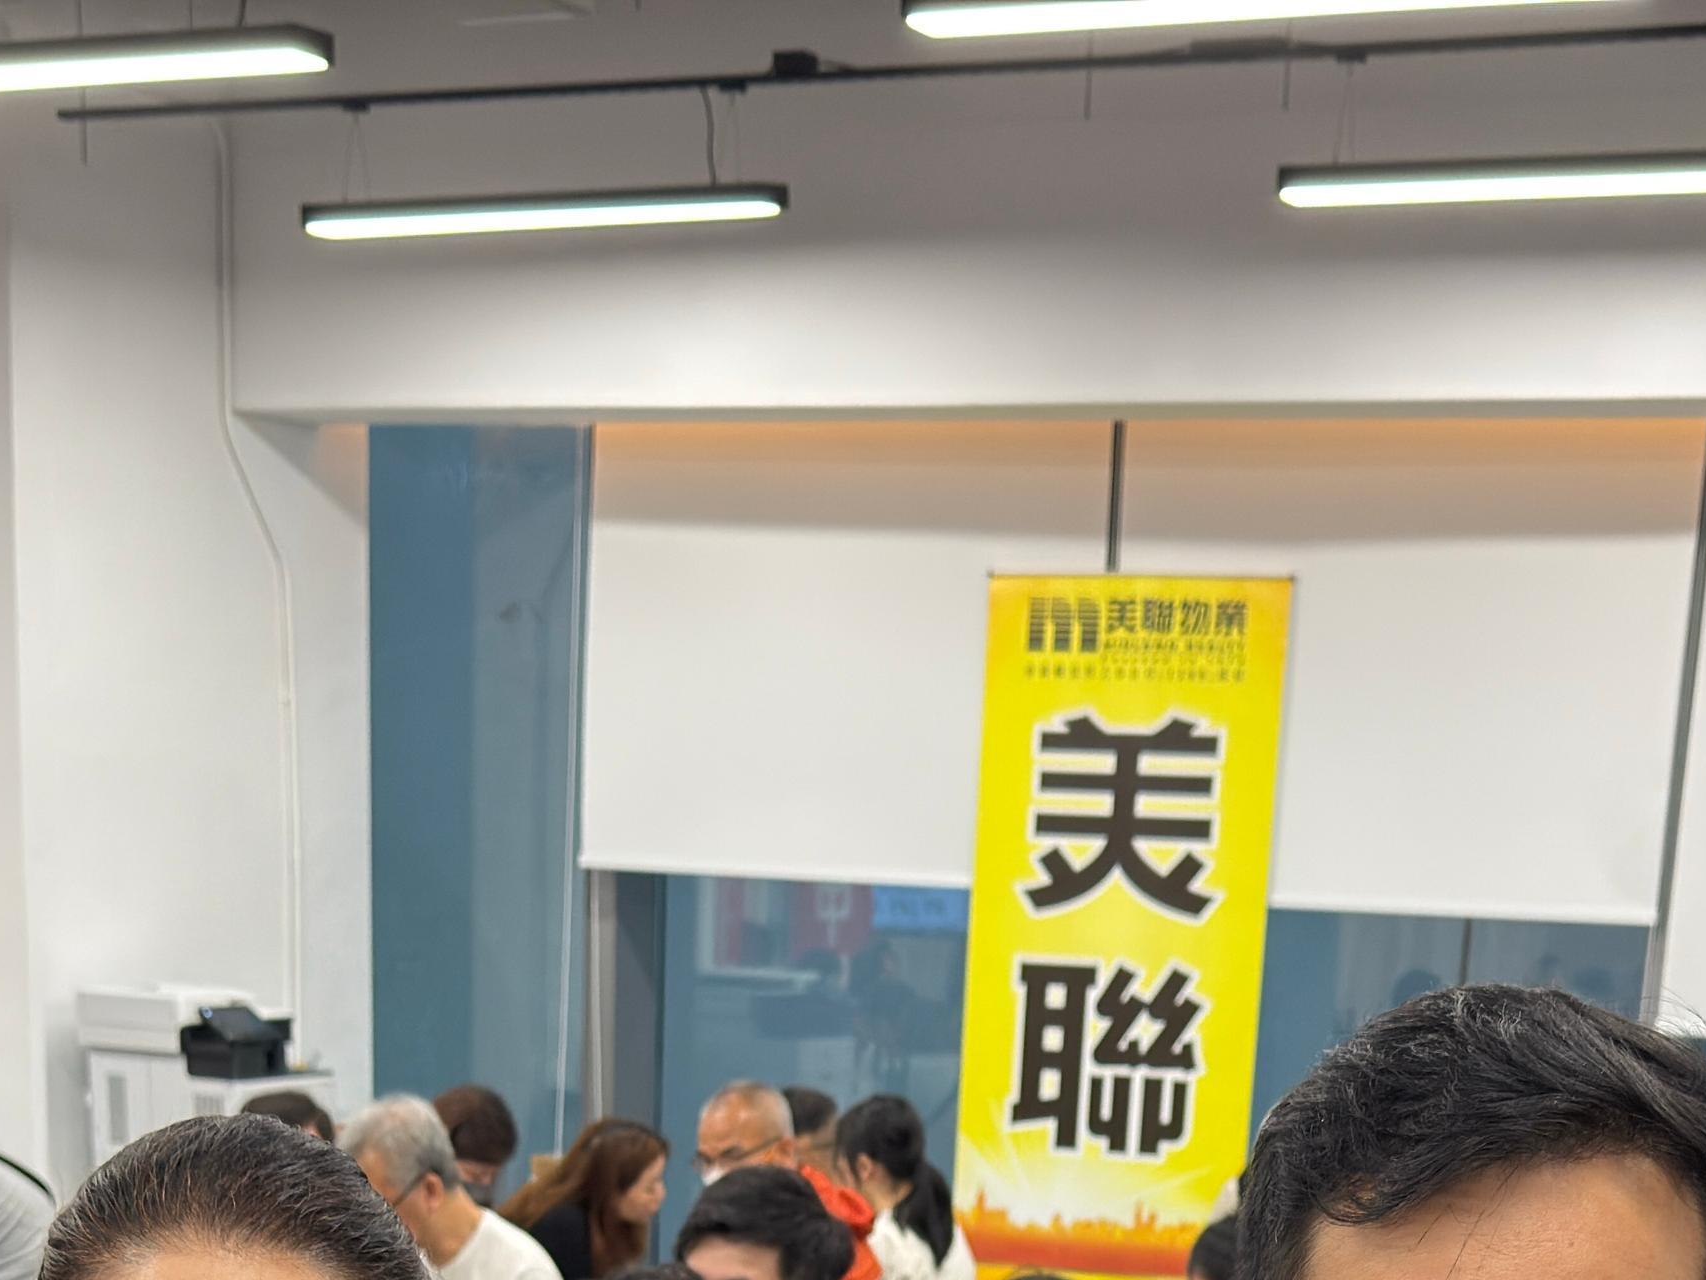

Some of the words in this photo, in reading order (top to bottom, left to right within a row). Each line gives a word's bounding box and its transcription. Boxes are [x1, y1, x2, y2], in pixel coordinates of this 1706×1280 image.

[1106, 598, 1250, 637] 美聯物業
[1010, 713, 1225, 1154] 美聯
